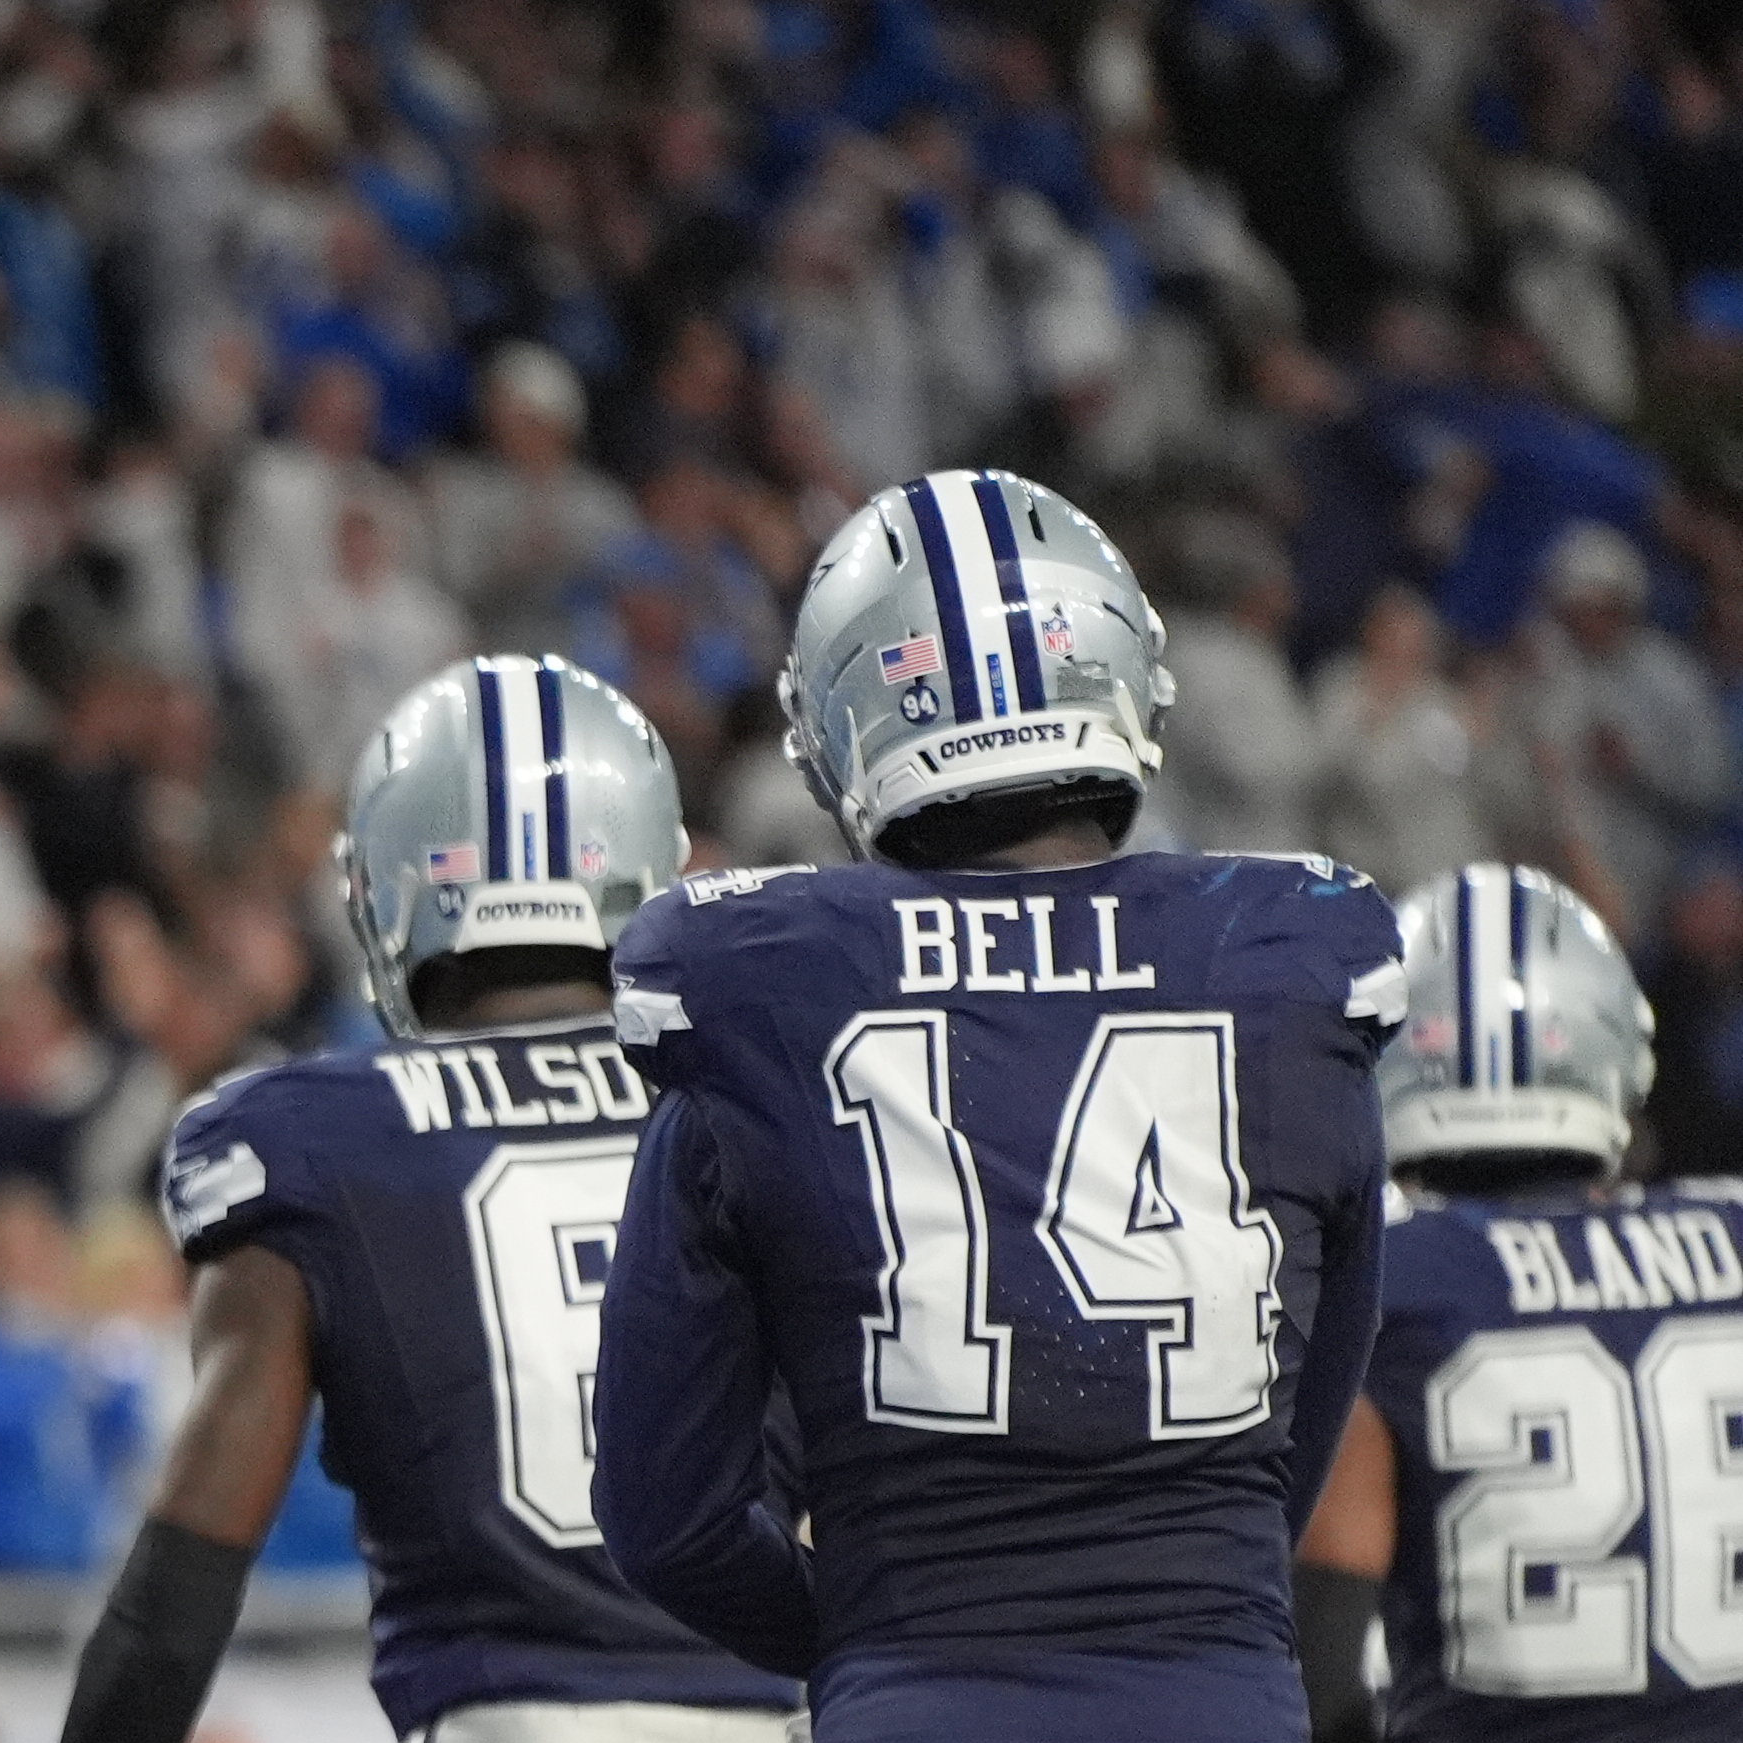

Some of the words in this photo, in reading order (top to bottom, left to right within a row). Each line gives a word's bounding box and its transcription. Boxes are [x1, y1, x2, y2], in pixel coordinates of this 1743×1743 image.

[903, 692, 937, 720] 94
[941, 724, 1065, 759] COWBOYS
[892, 896, 1156, 994] BELL
[376, 1042, 659, 1132] WILSO
[822, 1008, 1282, 1440] 14
[1488, 1210, 1743, 1313] BLAND
